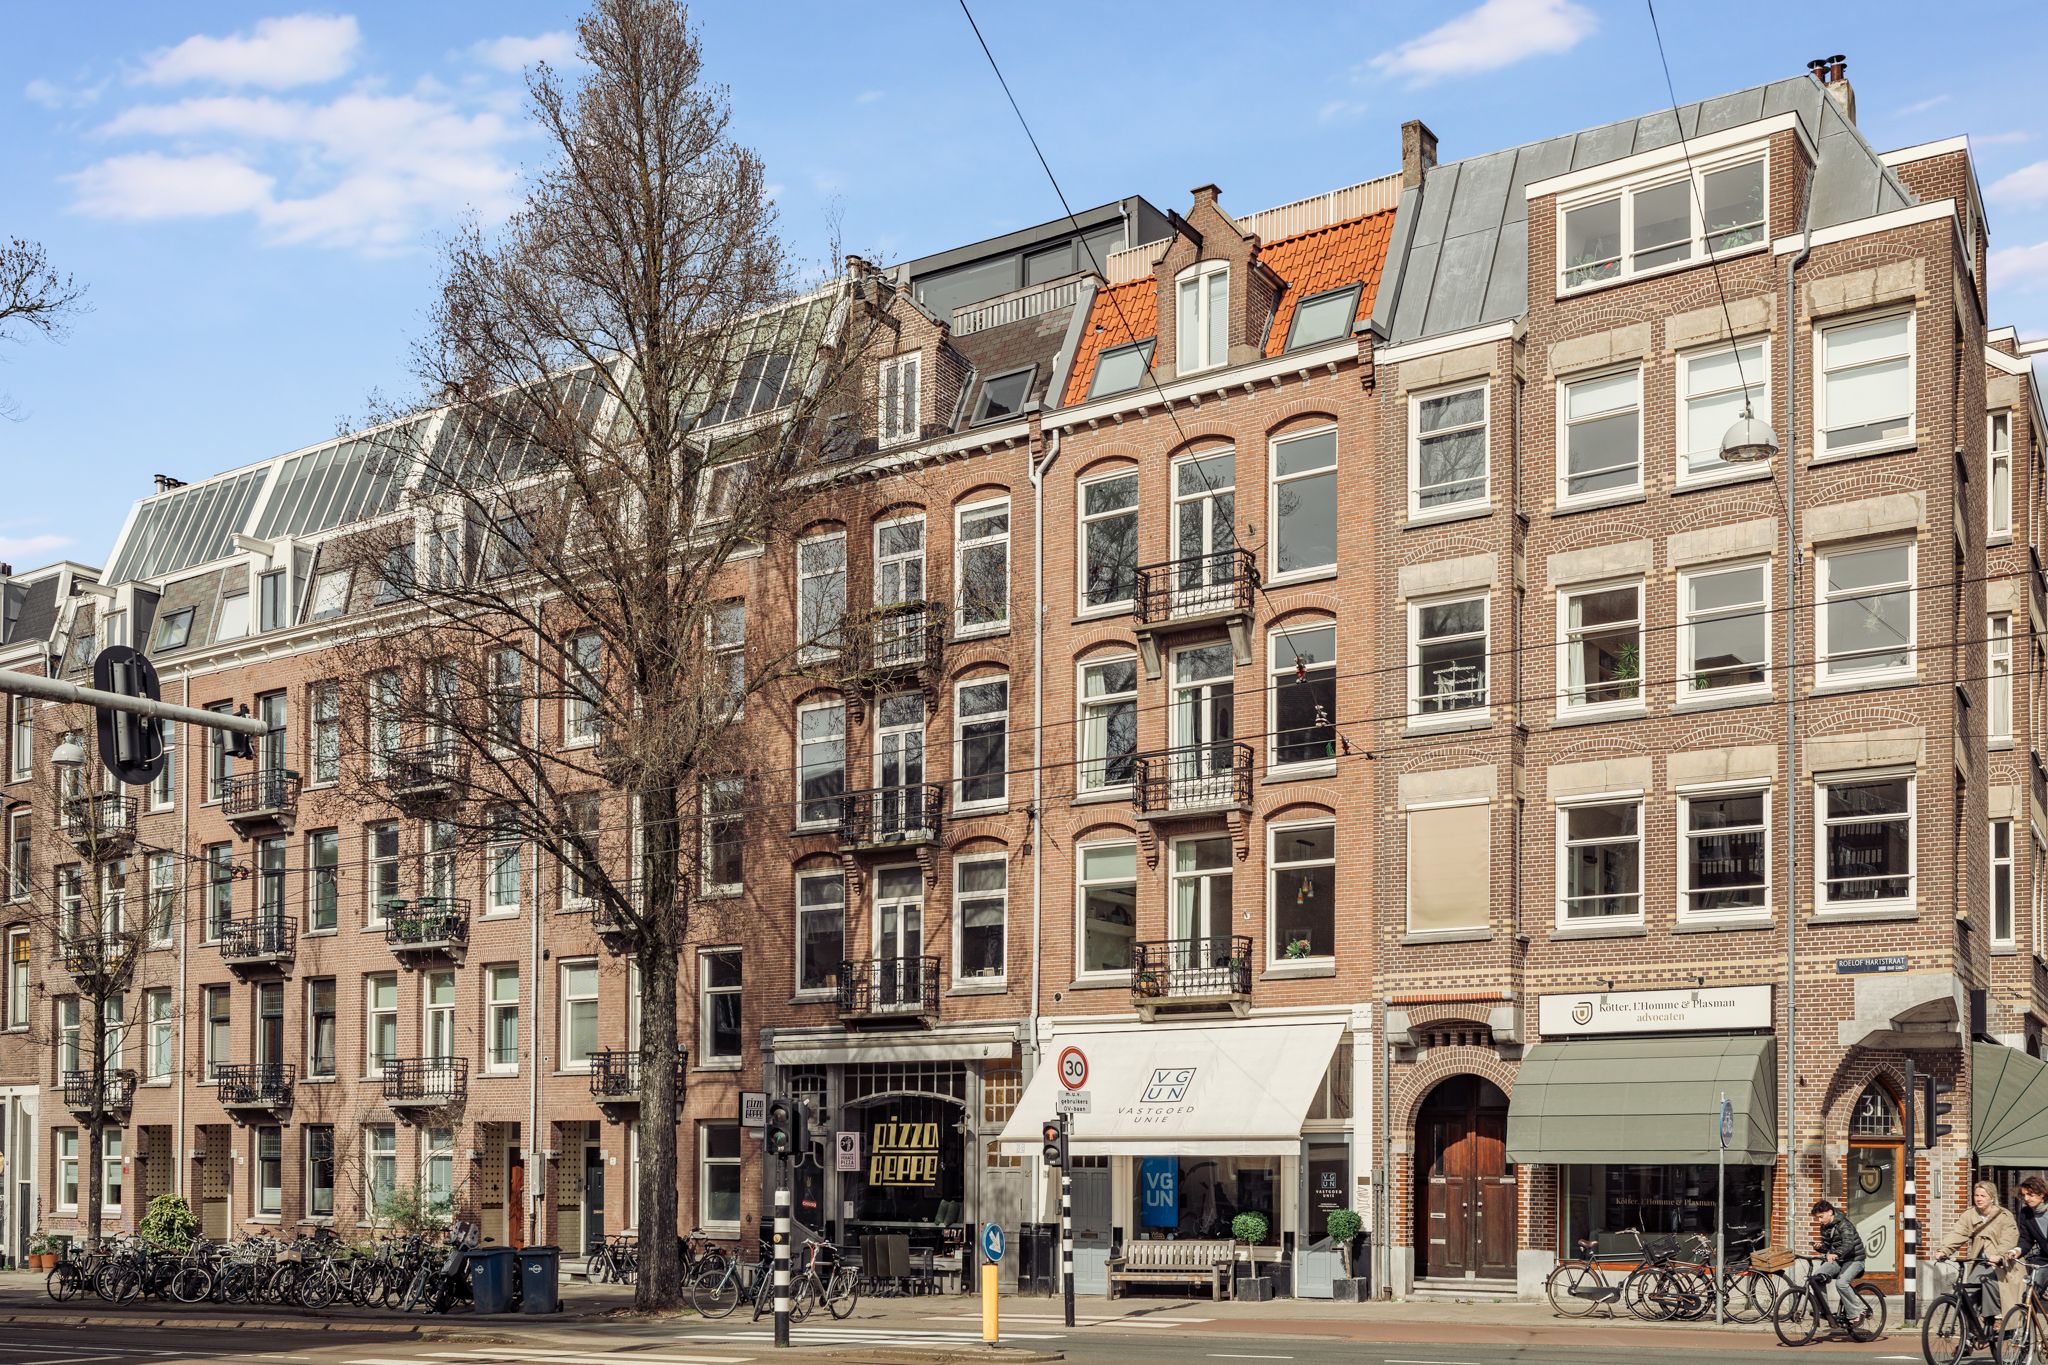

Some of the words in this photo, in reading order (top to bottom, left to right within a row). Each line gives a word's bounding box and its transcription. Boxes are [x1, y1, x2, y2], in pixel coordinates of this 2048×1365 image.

[1839, 959, 1864, 967] ROELOF
[1865, 957, 1905, 966] HARTSTRAAT
[1600, 1000, 1631, 1012] Kötter,
[1681, 999, 1690, 1009] &
[1692, 998, 1736, 1008] Plasman
[1636, 1012, 1685, 1022] advocaten
[1065, 1060, 1084, 1077] 30
[1118, 1106, 1195, 1115] VASTGOED
[1862, 1095, 1881, 1117] 31
[1146, 1172, 1173, 1189] VG
[1146, 1190, 1173, 1207] UN
